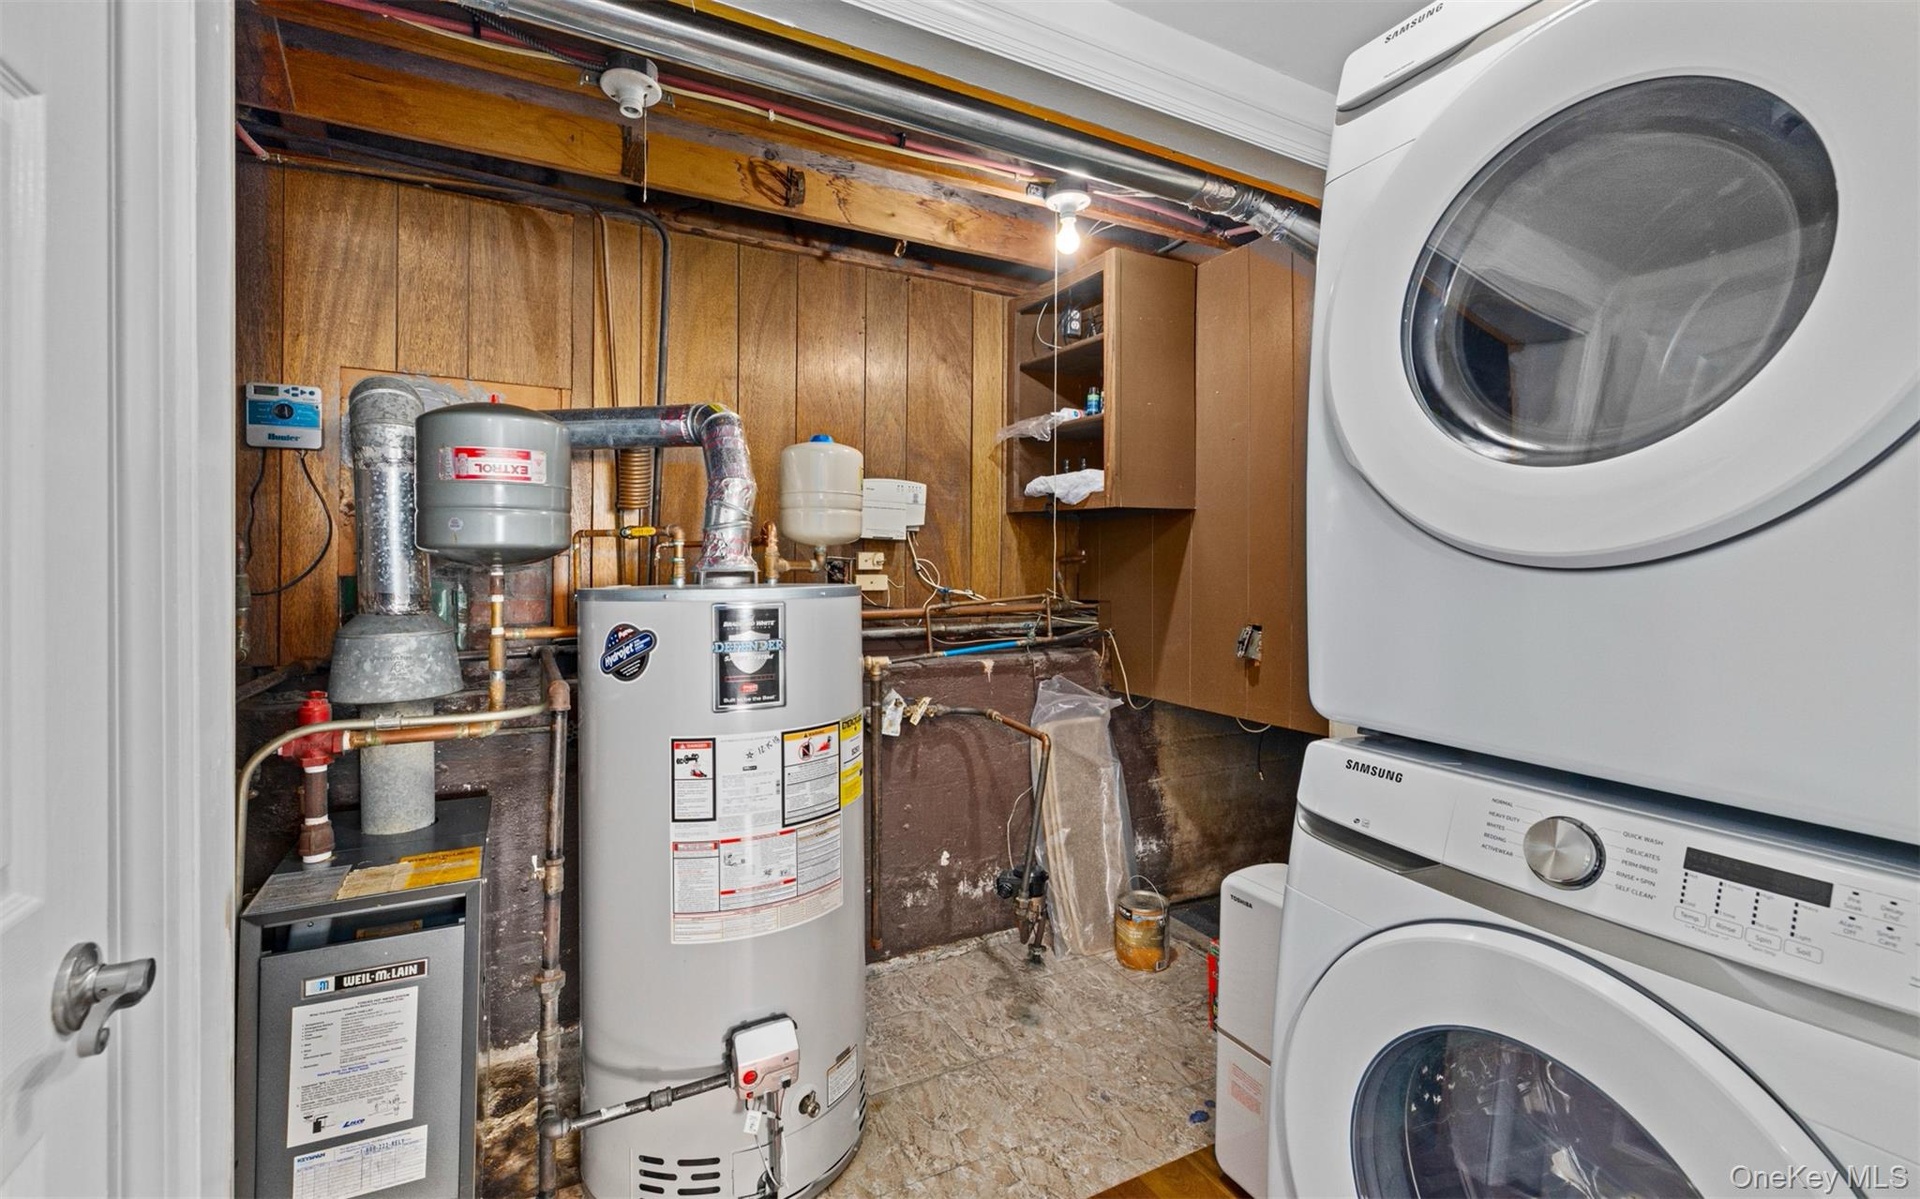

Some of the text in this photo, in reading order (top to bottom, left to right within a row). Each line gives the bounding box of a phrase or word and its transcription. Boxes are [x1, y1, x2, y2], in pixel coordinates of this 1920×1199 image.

[1384, 3, 1444, 44] SAMSUNG
[267, 433, 301, 442] Hunter
[474, 463, 529, 475] EXTROL
[713, 639, 785, 653] DEFENDER
[604, 643, 634, 667] Hydrojet
[1345, 759, 1403, 783] SAMSUNG
[1492, 798, 1513, 807] NORMAL
[1484, 832, 1507, 843] BEDDING
[1623, 831, 1664, 846] QUICK WASH
[1482, 843, 1513, 856] ACTIVEWEAR
[1626, 847, 1661, 861] DELICATES
[1621, 859, 1658, 874] PERM PRESS
[1616, 870, 1635, 881] RINSE
[1641, 878, 1656, 887] SPIN
[1615, 883, 1630, 892] SELF
[1230, 894, 1253, 909] TOSHIBA
[1755, 934, 1772, 945] Spin
